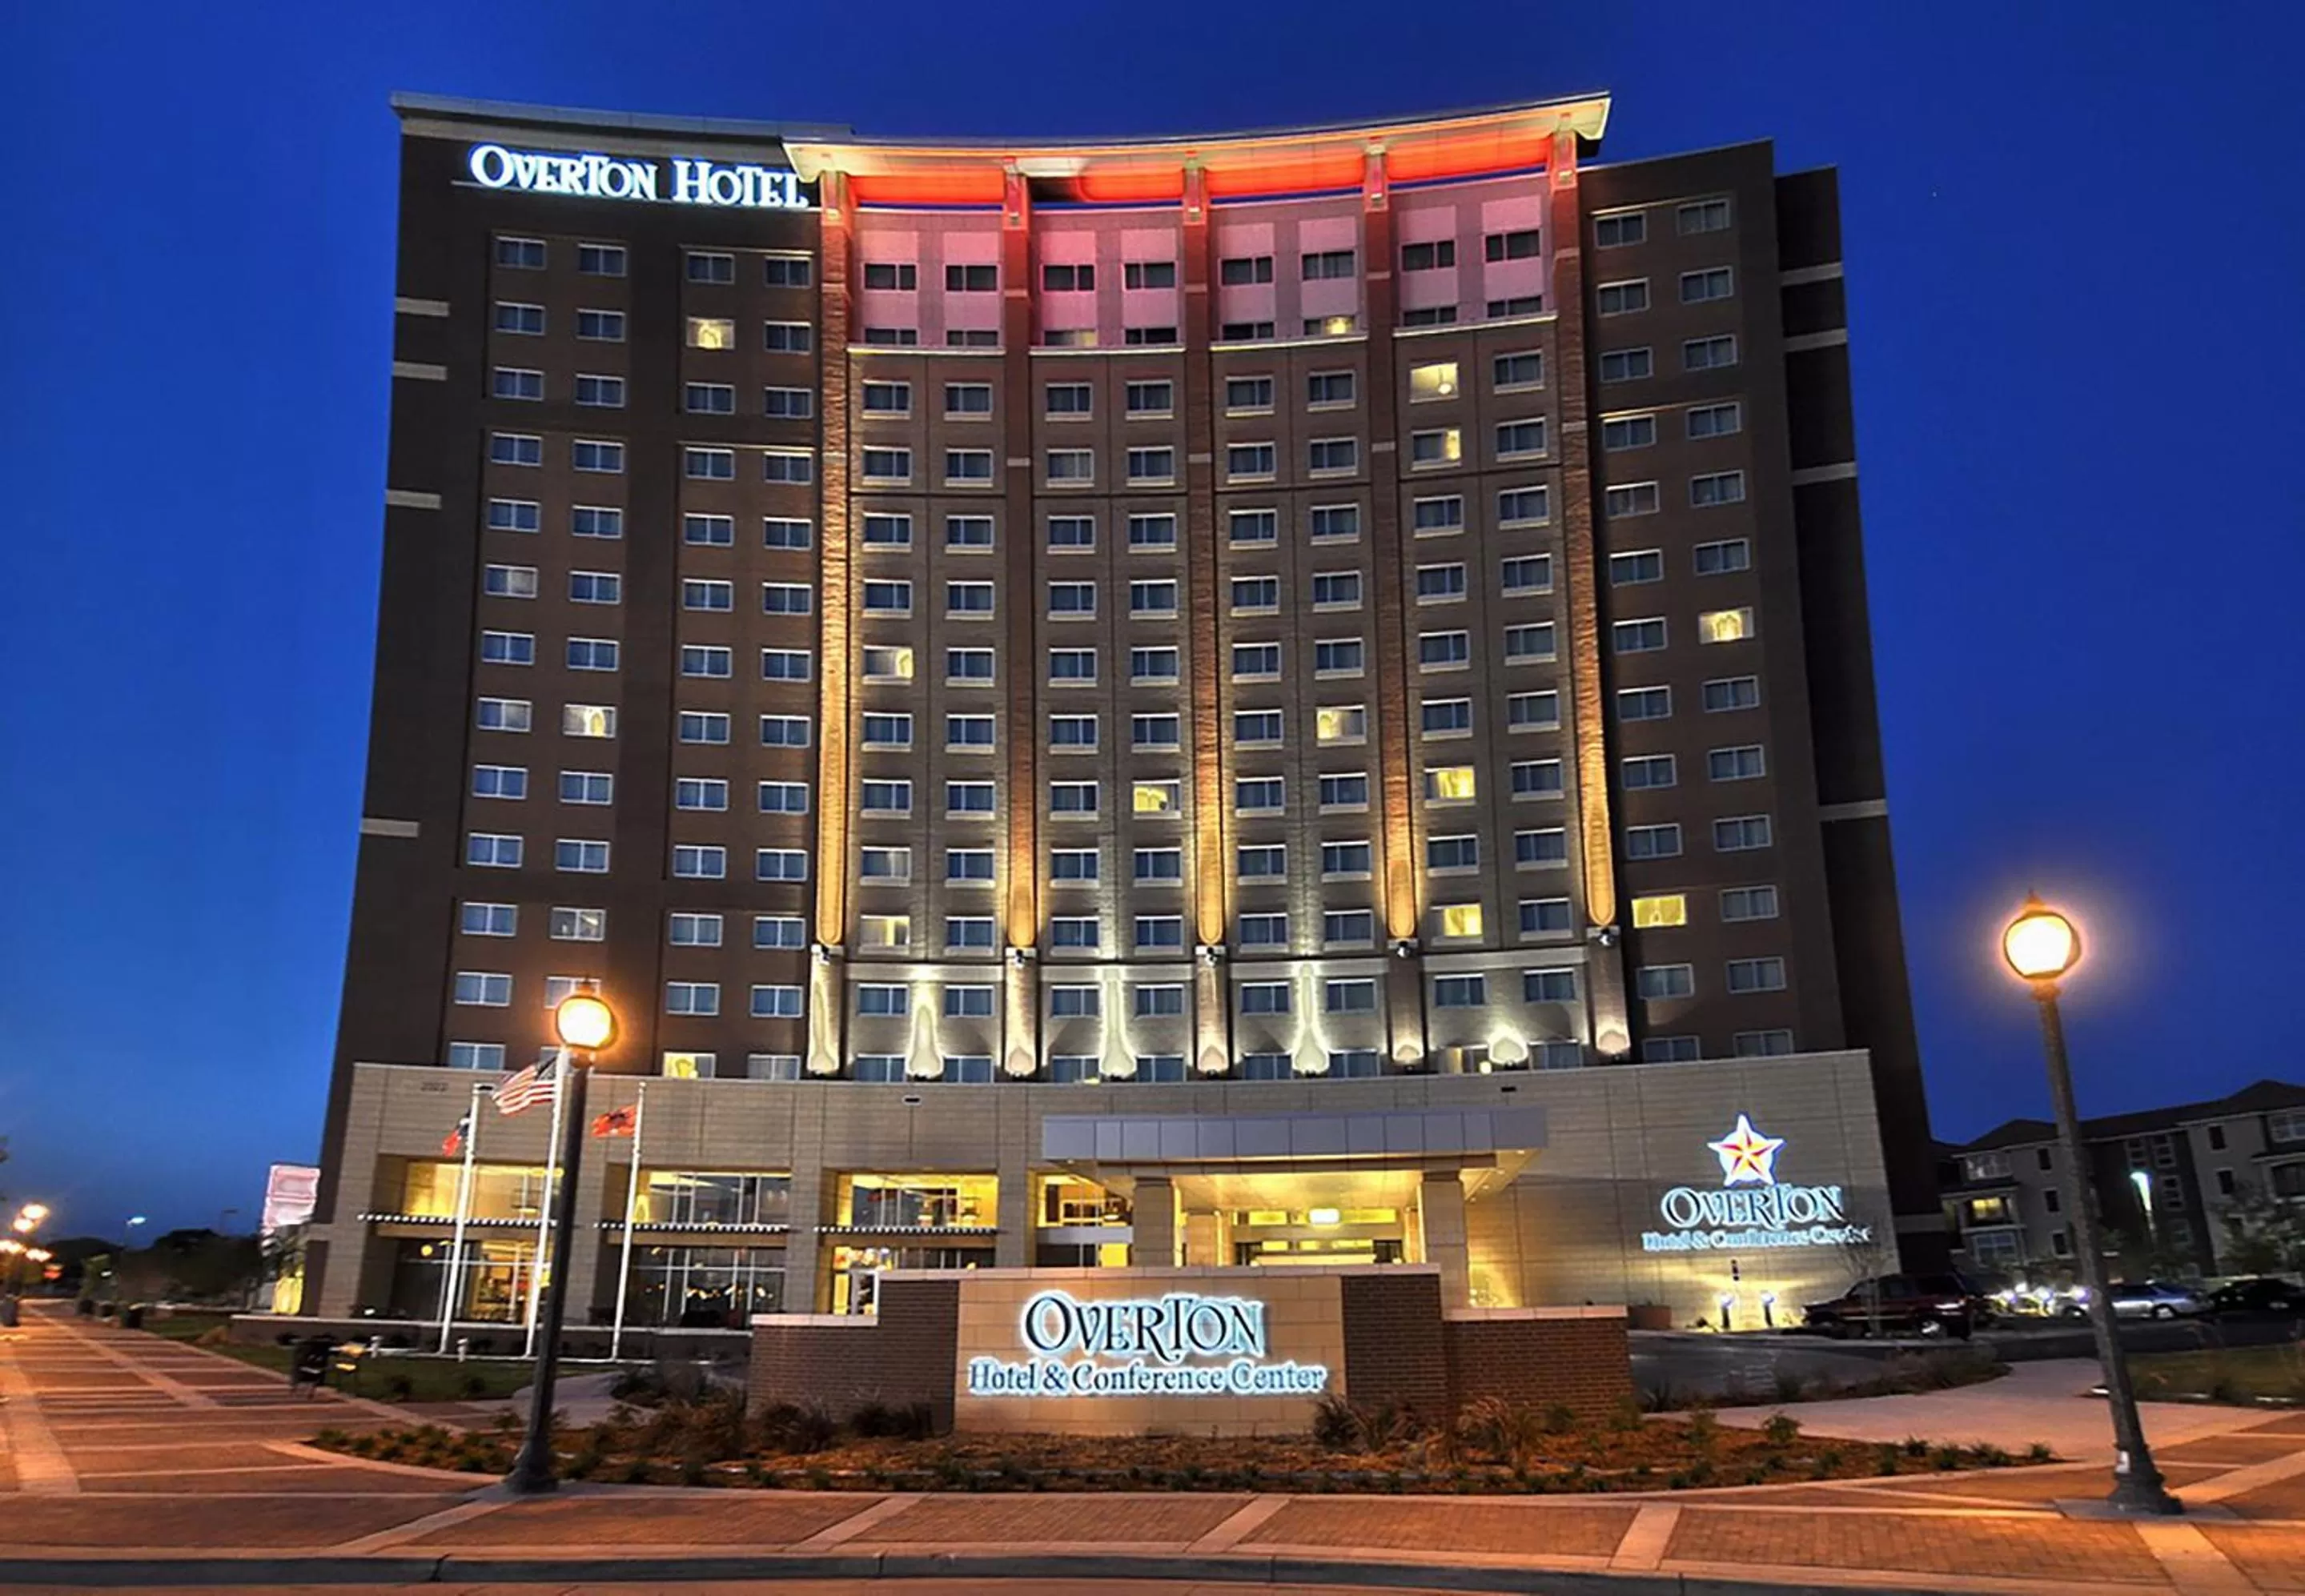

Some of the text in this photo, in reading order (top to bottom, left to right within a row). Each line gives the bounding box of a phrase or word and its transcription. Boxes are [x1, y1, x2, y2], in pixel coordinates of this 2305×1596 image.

[469, 144, 809, 209] OVERTON HOTEL
[1661, 1184, 1846, 1230] OVERTON
[1022, 1291, 1267, 1364] OVERTON
[969, 1361, 1325, 1392] Hotel & Conference Center
